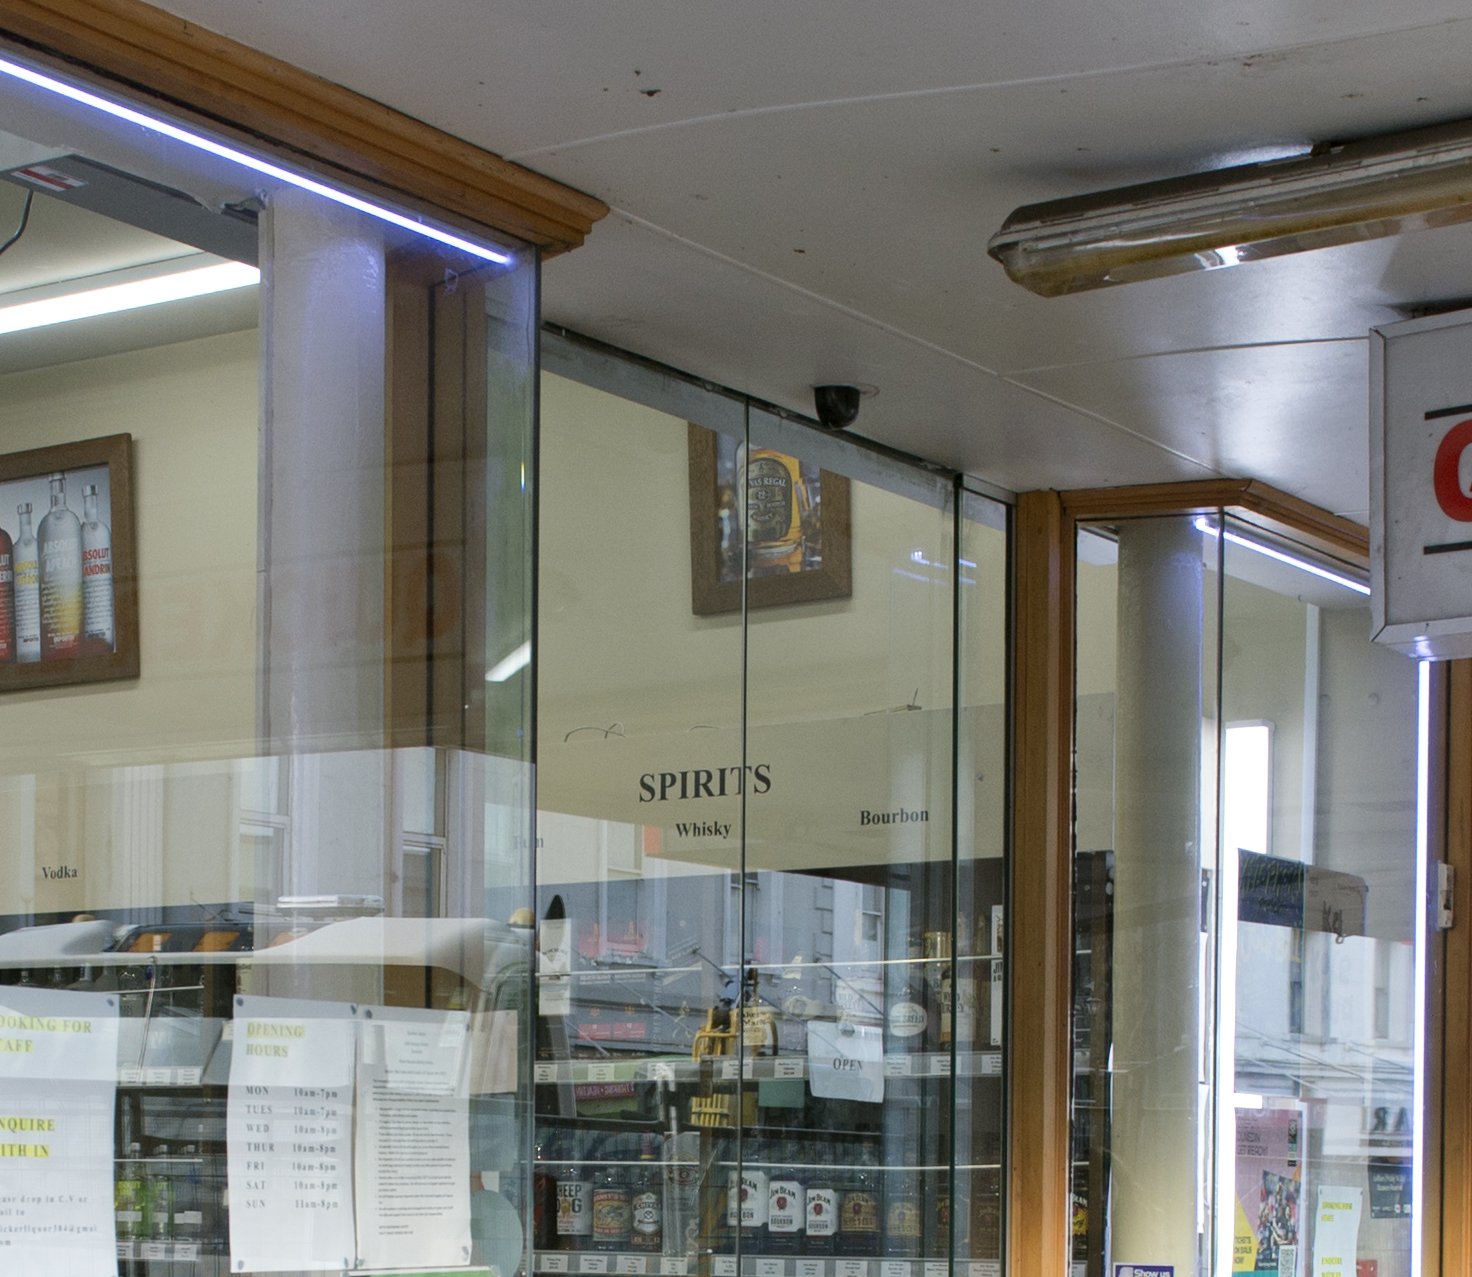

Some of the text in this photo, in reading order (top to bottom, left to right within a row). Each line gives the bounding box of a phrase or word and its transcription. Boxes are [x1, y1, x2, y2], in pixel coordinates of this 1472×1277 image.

[639, 764, 771, 803] SPIRITS
[860, 808, 929, 826] Bourbon
[676, 822, 731, 839] Whisky
[42, 866, 77, 880] Vodka
[62, 1020, 92, 1033] FOR
[247, 1022, 303, 1038] OPENING
[246, 1043, 288, 1057] HOURS
[832, 1057, 863, 1072] OPEN
[245, 1085, 269, 1096] MON
[245, 1104, 273, 1114] TUES
[246, 1124, 270, 1133] WED
[33, 1144, 50, 1157] IN
[246, 1143, 275, 1152] THUR
[246, 1162, 265, 1171] FRI
[245, 1181, 266, 1190] SAT
[246, 1199, 266, 1208] SUN
